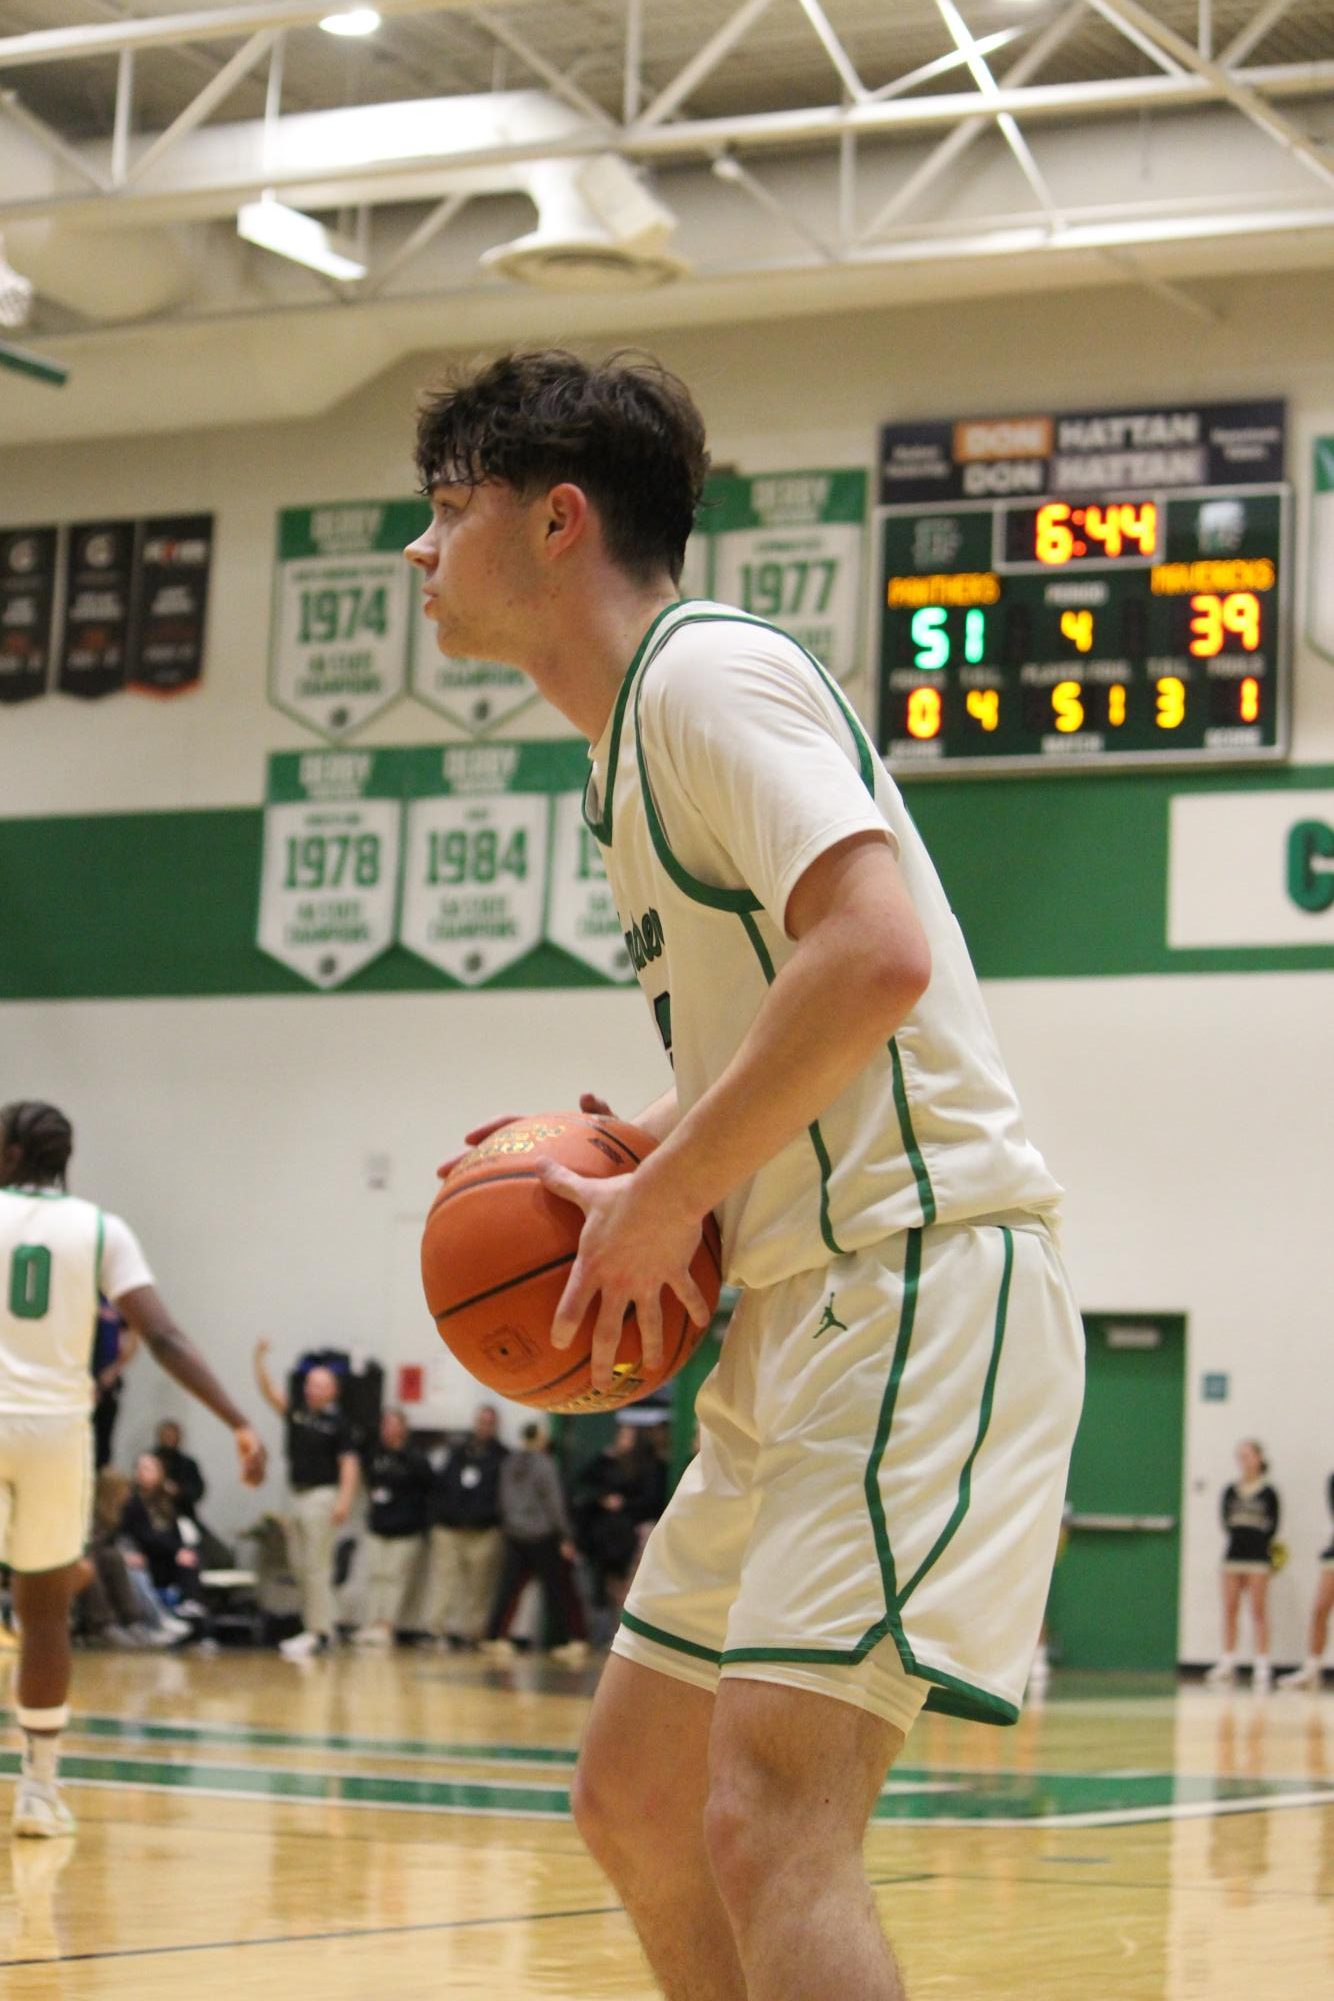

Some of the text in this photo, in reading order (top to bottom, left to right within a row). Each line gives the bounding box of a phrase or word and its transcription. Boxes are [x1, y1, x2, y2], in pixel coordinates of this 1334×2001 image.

[965, 412, 1199, 456] DON HATTAN
[962, 459, 1043, 495] DON
[1036, 503, 1157, 564] 6:44
[297, 586, 388, 644] 1974
[741, 558, 838, 616] 1977
[1060, 610, 1093, 653] 4
[1189, 592, 1261, 658] 39
[907, 686, 942, 740] 0
[966, 688, 999, 732] 4
[1155, 675, 1186, 729] 3
[1239, 675, 1260, 723] 1
[285, 833, 381, 891] 1978
[426, 827, 528, 885] 1984
[9, 1243, 52, 1320] 0
